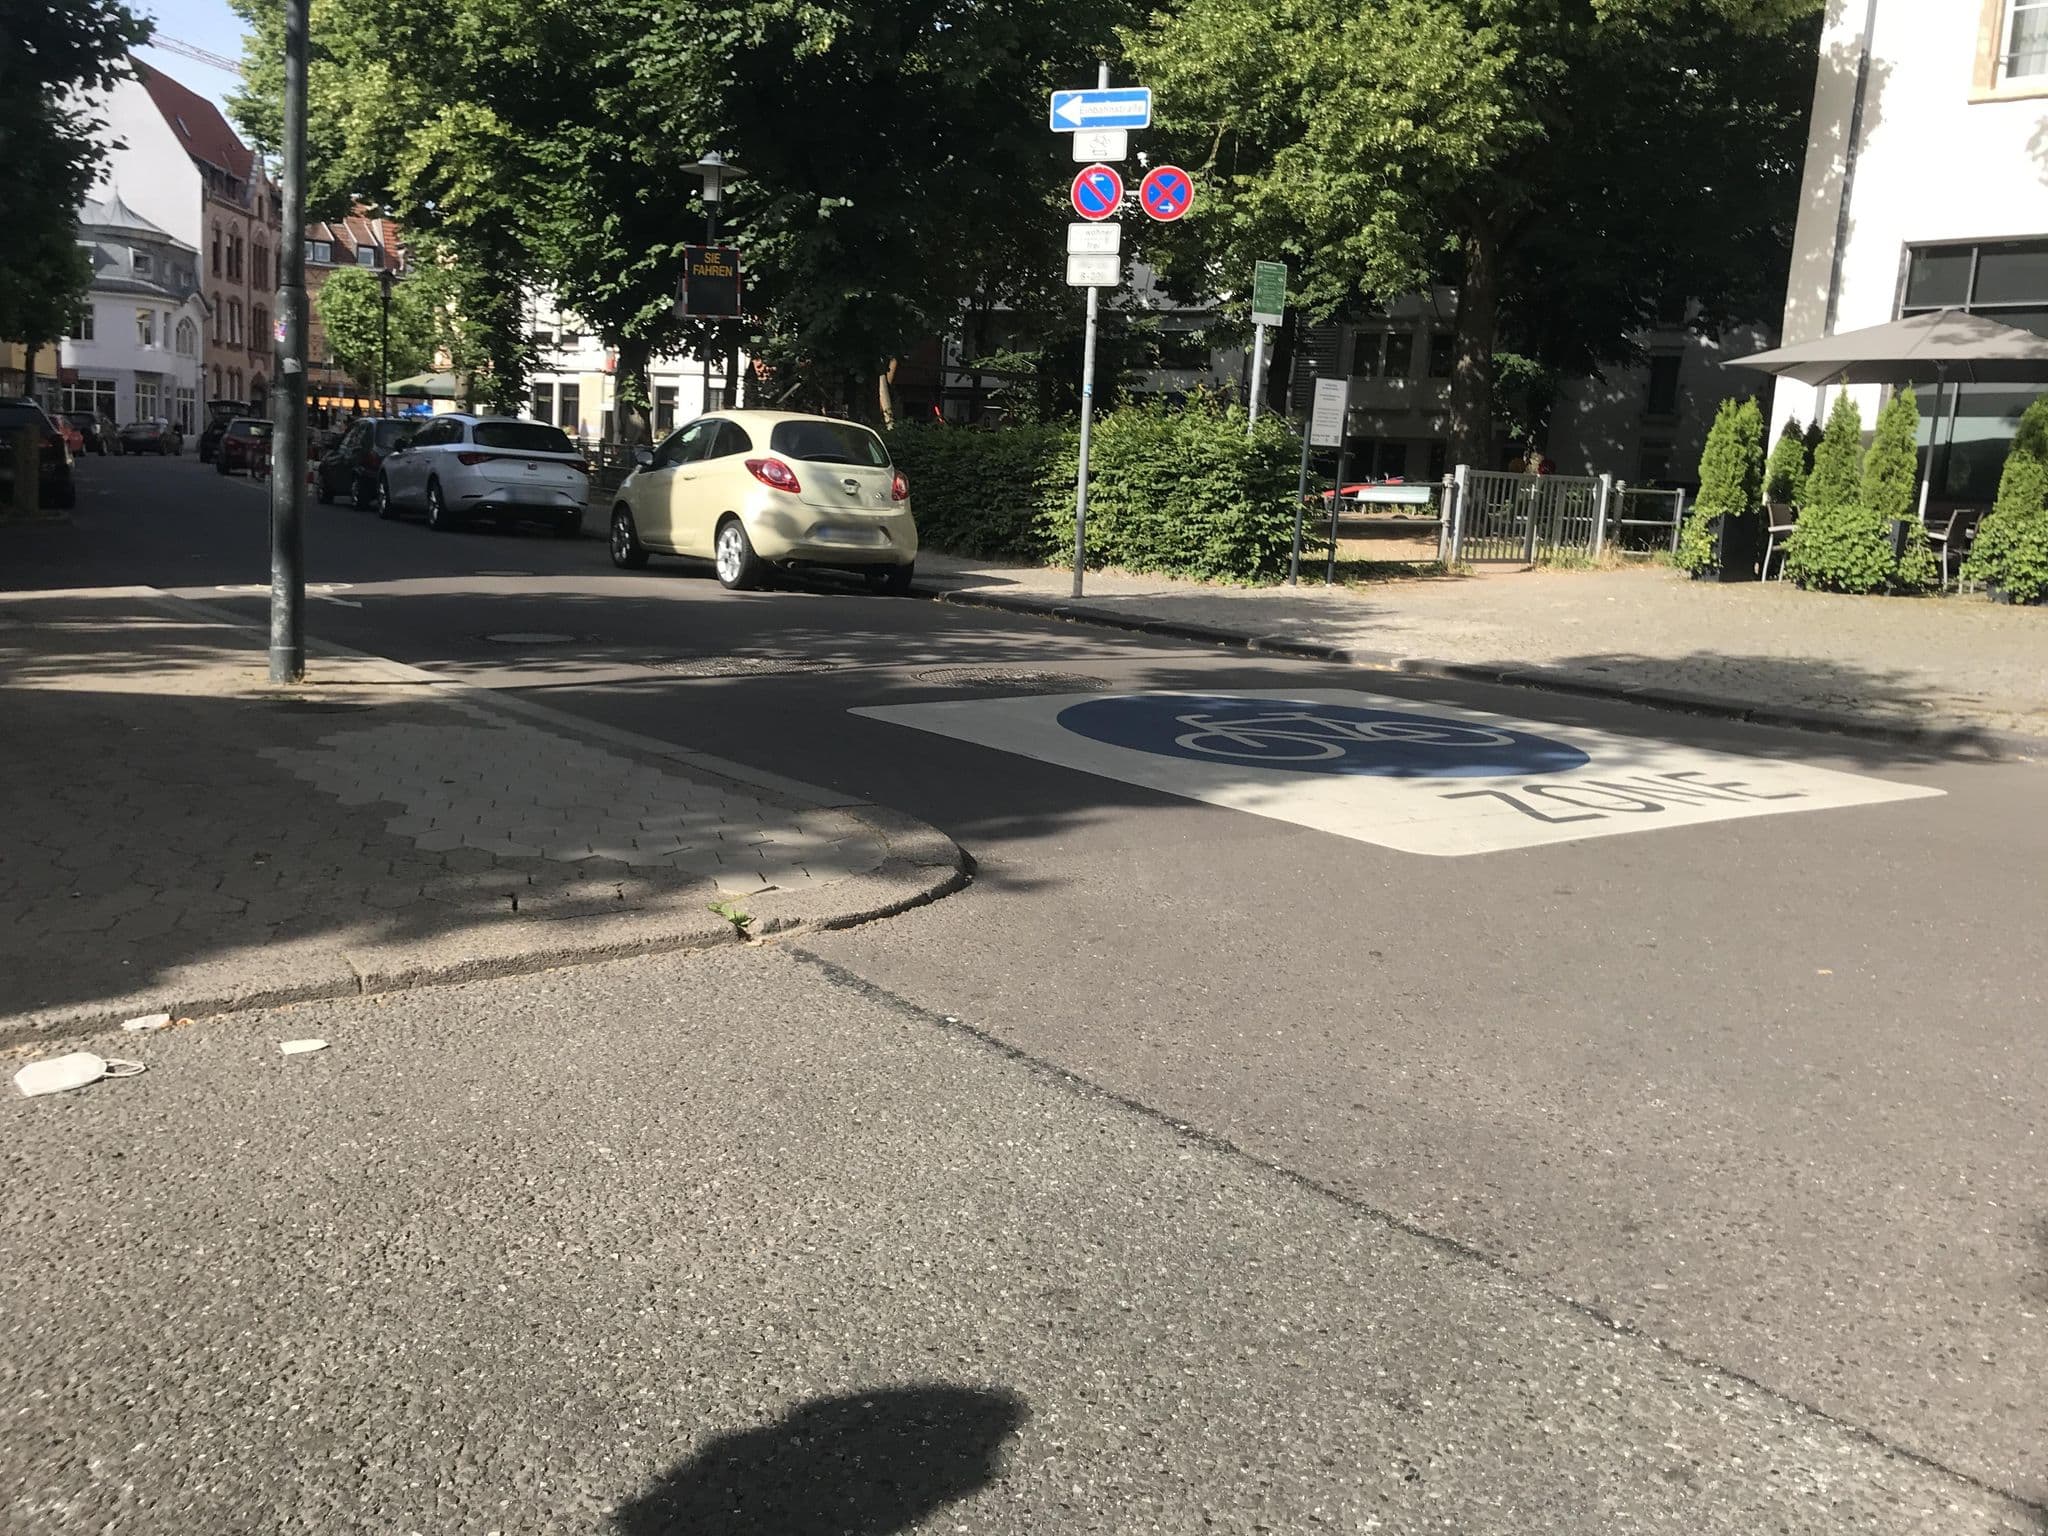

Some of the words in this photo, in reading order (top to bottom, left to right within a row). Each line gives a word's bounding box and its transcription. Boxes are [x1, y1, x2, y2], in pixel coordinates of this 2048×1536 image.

[703, 252, 721, 264] SIE
[692, 264, 733, 277] FAHREN
[1437, 771, 1809, 824] ZONE
